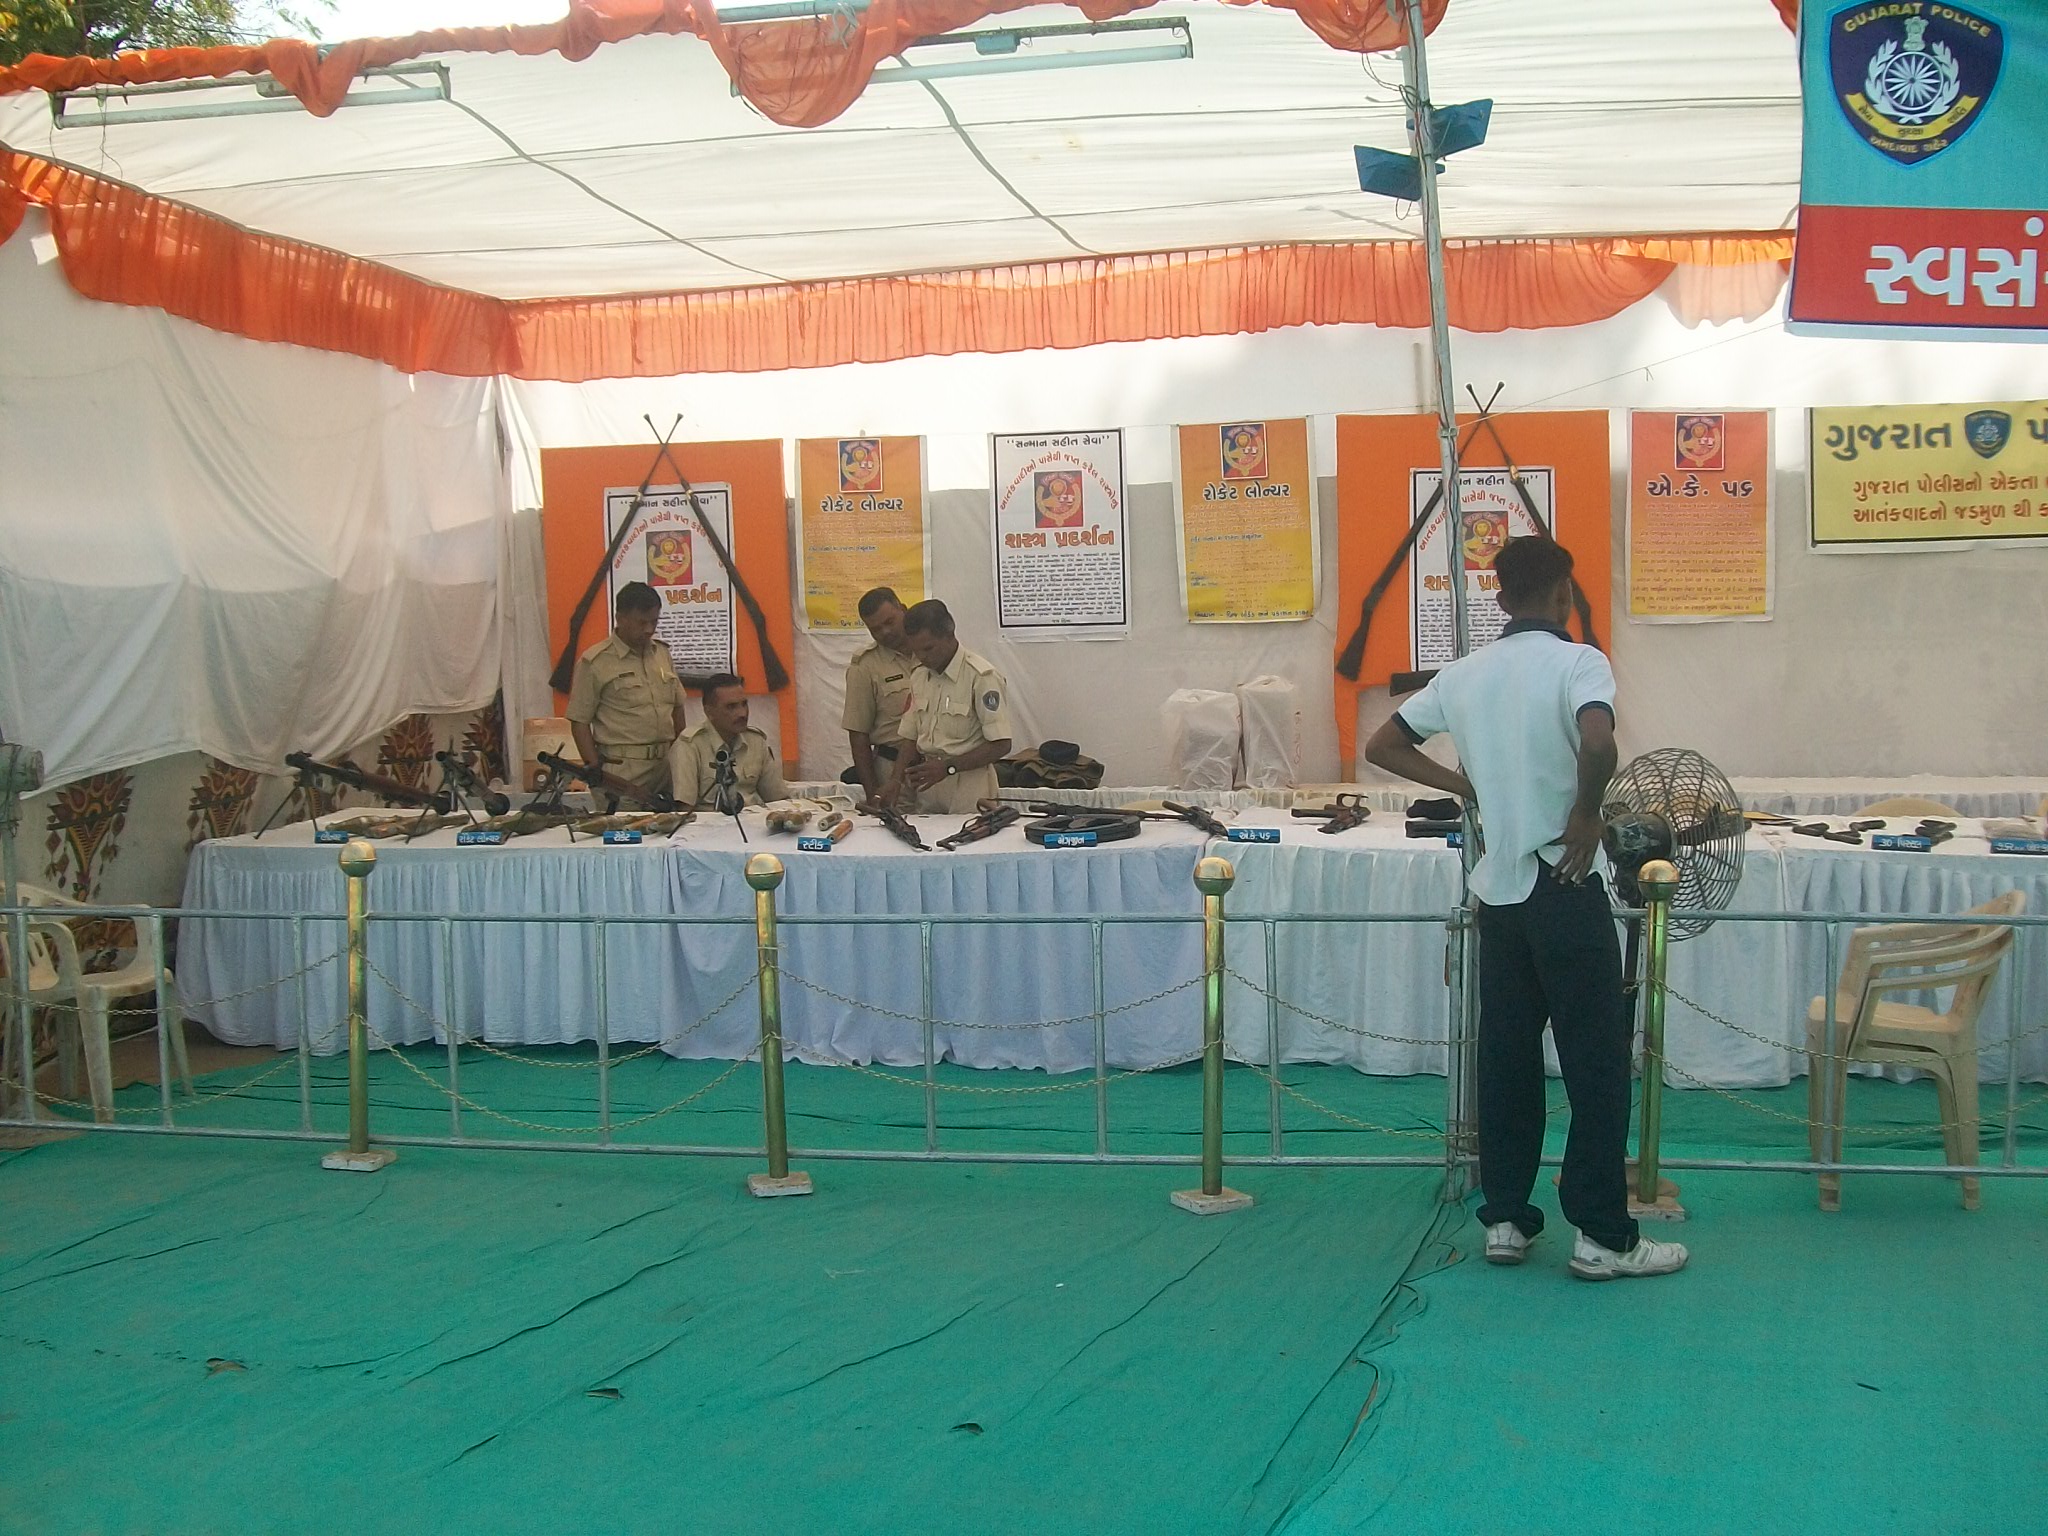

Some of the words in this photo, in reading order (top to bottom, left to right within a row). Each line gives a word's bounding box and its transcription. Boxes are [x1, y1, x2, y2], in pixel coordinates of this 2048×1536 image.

[1844, 2, 1922, 32] GUJARAT
[1930, 5, 1991, 38] POLICE
[1824, 423, 1953, 461] ગુજરાત
[1203, 482, 1239, 500] રોકેટ
[1245, 481, 1291, 498] લોન્ચર
[1853, 479, 1909, 501] ગુજરાત
[1990, 470, 2038, 491] એકતા
[821, 495, 854, 512] રોકેટ
[860, 494, 904, 512] લોન્ચર
[1853, 500, 1948, 523] આતંકવાદનો
[1955, 503, 2006, 525] જડમુળ
[2014, 499, 2031, 518] થી
[1053, 524, 1115, 548] પ્રદર્શન
[665, 582, 723, 606] પ્રદર્શન
